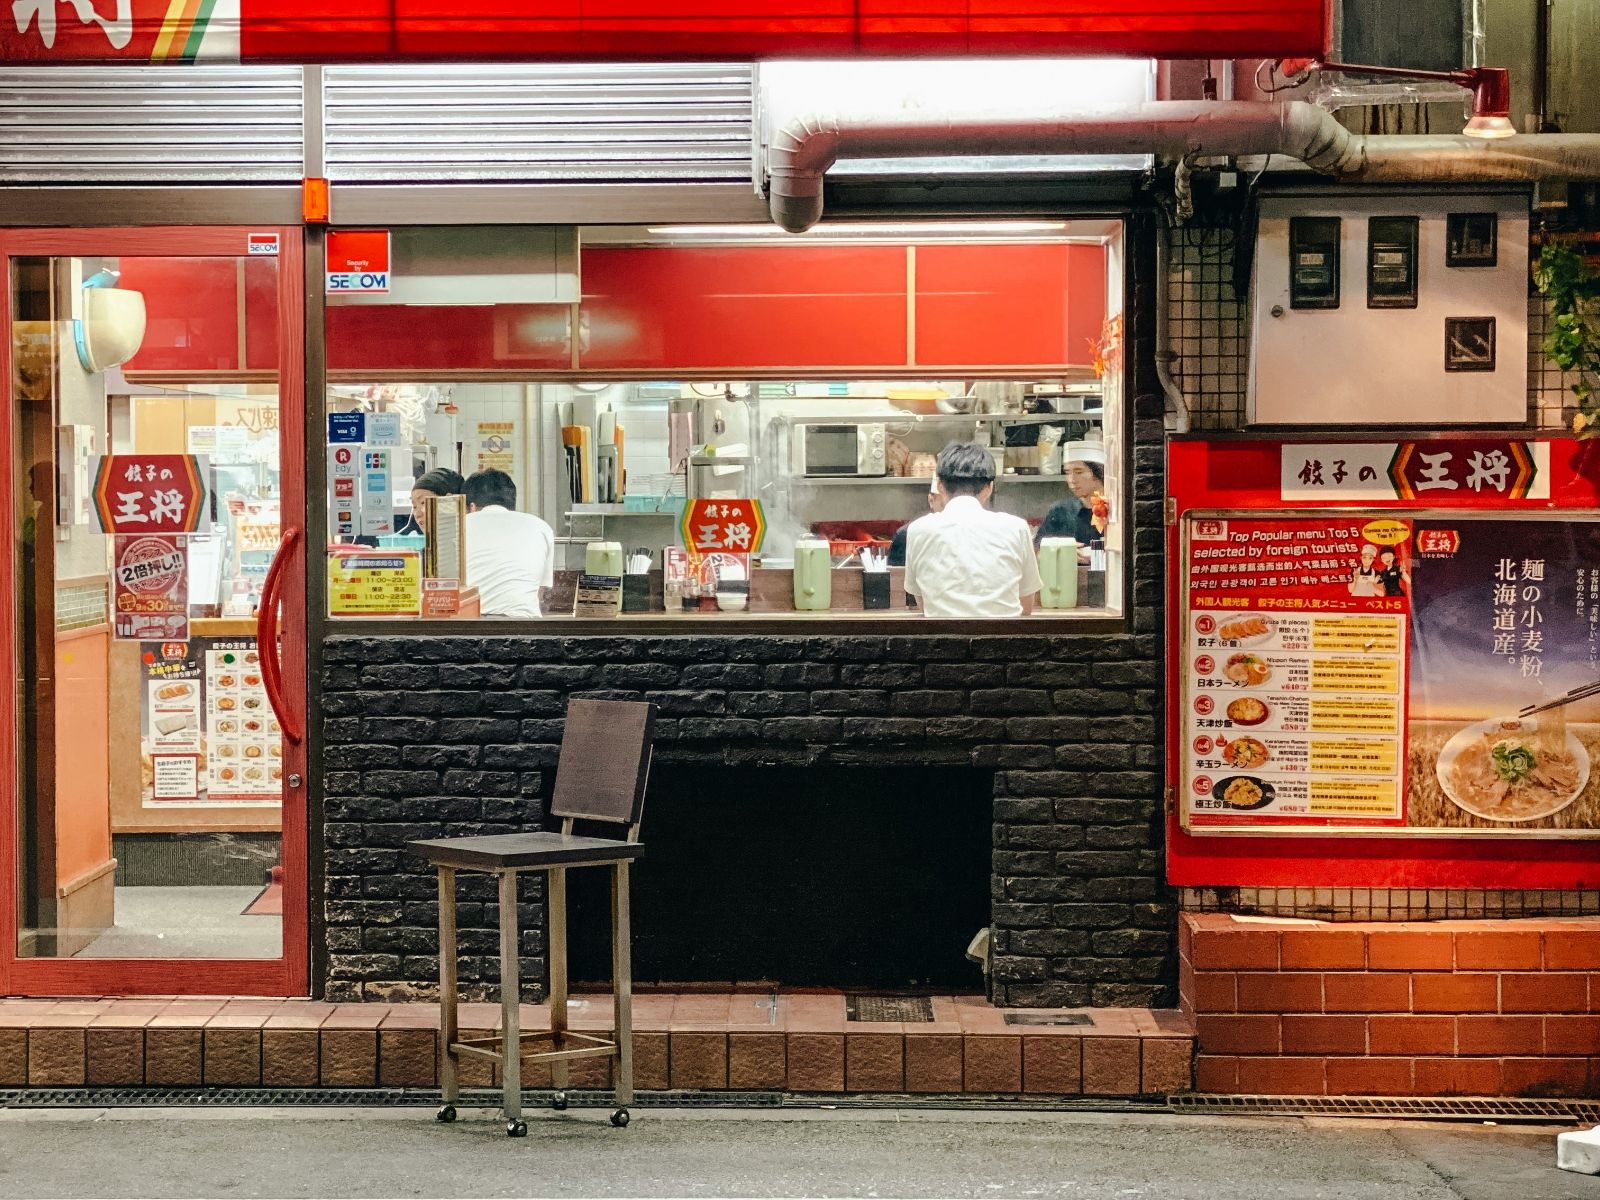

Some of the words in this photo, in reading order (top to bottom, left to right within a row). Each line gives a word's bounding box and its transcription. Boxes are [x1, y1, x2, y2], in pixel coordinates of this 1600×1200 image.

[250, 244, 277, 252] SECOM
[330, 274, 386, 288] SECOM
[125, 464, 173, 482] 餃子の
[335, 465, 352, 473] Edy
[1298, 459, 1377, 485] 餃子の
[1415, 449, 1511, 492] 王将
[114, 489, 185, 524] 王将
[704, 504, 742, 518] 餃子の
[696, 522, 751, 549] 王将
[1229, 532, 1249, 542] Top
[1252, 530, 1294, 541] Popular
[1297, 530, 1325, 539] menu
[1328, 528, 1348, 539] Top
[1350, 527, 1359, 537] 5
[1194, 546, 1246, 558] selected
[1249, 546, 1263, 558] by
[1266, 544, 1308, 556] foreign
[1311, 542, 1358, 554] tourists
[1425, 540, 1451, 551] 王将
[1190, 579, 1217, 589] 외국인
[1221, 578, 1256, 588] 관광객이
[1260, 577, 1277, 586] 고른
[1280, 576, 1298, 586] 인기
[1366, 601, 1402, 609] ベスト5
[1492, 559, 1517, 664] 北海道産。
[1198, 638, 1216, 646] 餃子
[1198, 679, 1249, 687] 日本ラーメン
[1196, 719, 1233, 727] 天津炒飯
[1196, 760, 1247, 768] 辛玉ラーメン
